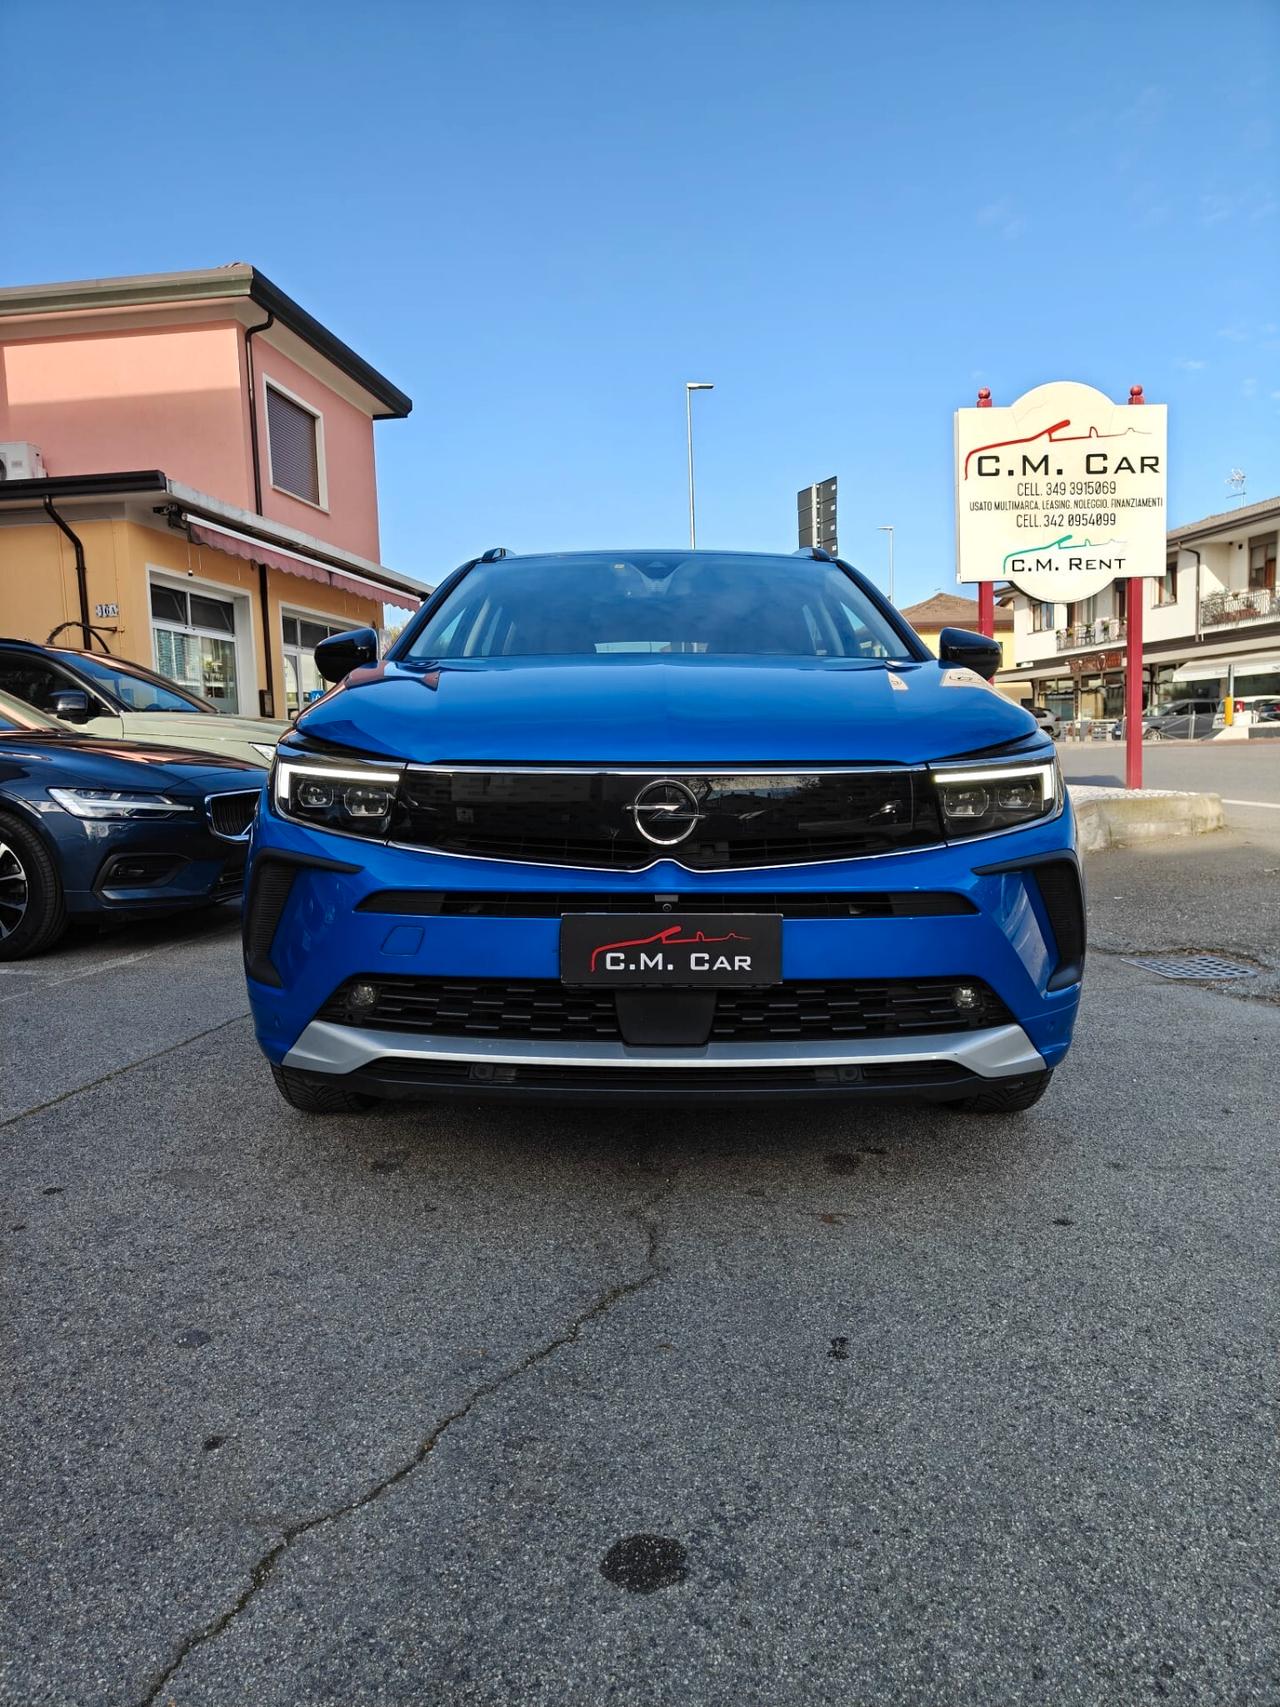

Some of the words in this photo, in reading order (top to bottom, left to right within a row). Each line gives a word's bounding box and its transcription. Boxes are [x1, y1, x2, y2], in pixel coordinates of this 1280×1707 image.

[977, 454, 1063, 476] C.M.
[1016, 482, 1043, 497] CELL.
[1046, 481, 1066, 496] 349
[1069, 480, 1117, 495] 3915069
[969, 501, 993, 511] USATO
[1111, 497, 1163, 508] FINANZIAMENTI
[1016, 513, 1042, 528] CELL.
[1043, 513, 1065, 527] 342
[1067, 512, 1117, 527] 0954099
[1011, 558, 1060, 573] C.M.
[605, 952, 674, 971] C.M.
